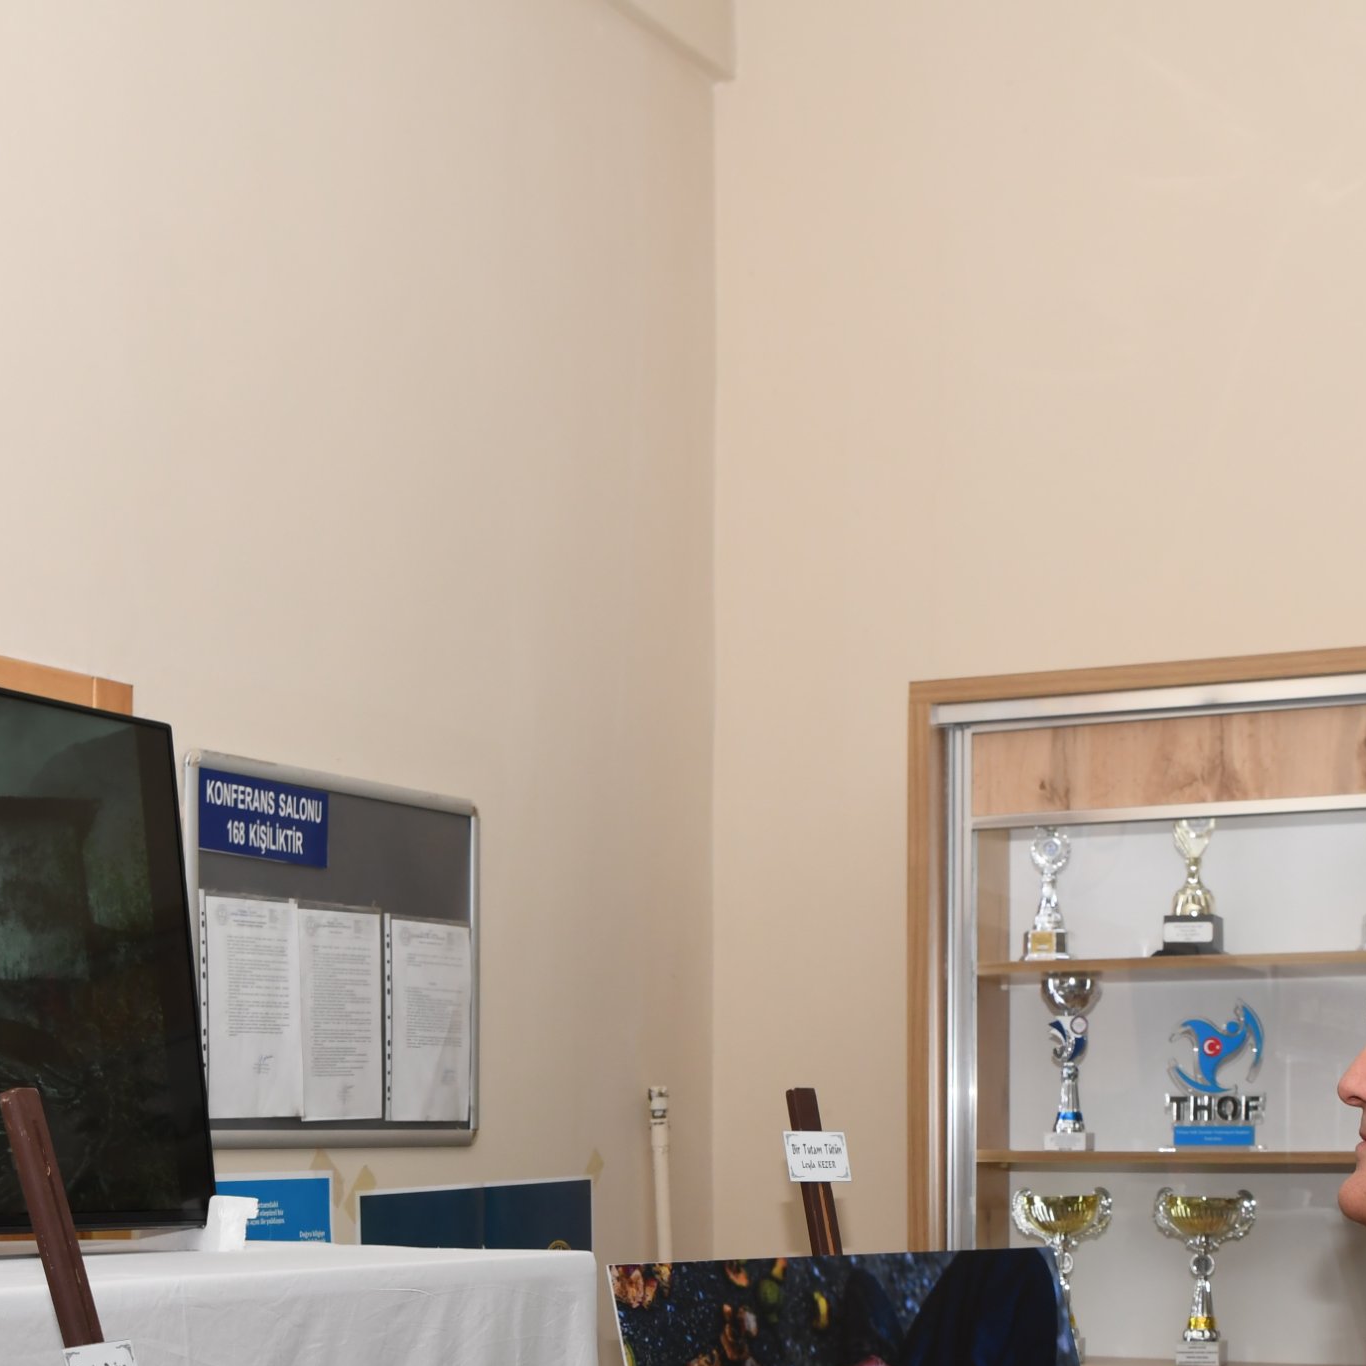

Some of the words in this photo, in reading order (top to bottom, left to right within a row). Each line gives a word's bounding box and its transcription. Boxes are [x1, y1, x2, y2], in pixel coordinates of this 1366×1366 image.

[206, 779, 275, 815] KONFERANS
[278, 793, 323, 824] SALONU
[227, 819, 246, 846] 168
[249, 820, 304, 855] KİŞİLİKTİR
[1169, 1095, 1262, 1122] THOF
[791, 1143, 801, 1155] Bir
[802, 1143, 823, 1155] Tutam
[801, 1160, 816, 1171] Leyla
